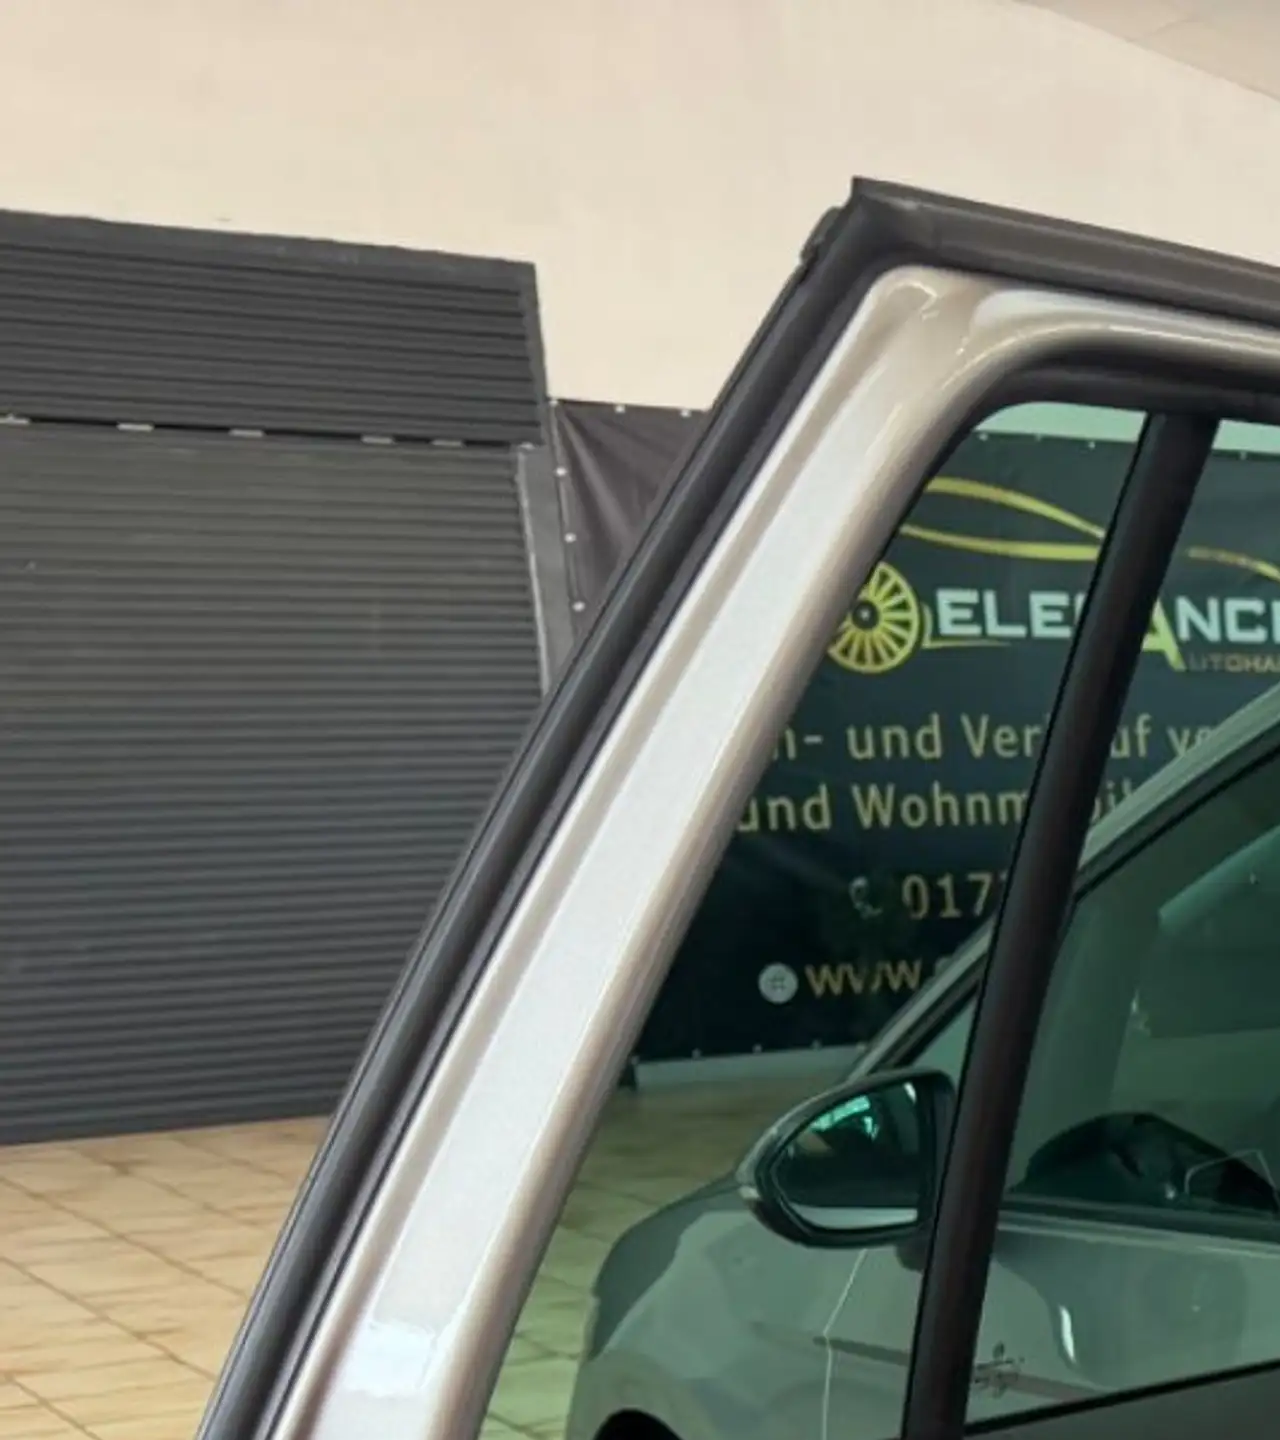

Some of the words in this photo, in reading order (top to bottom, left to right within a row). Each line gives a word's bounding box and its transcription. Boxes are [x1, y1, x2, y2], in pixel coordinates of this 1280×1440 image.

[846, 713, 943, 760] und
[959, 712, 1152, 760] Veruf
[902, 868, 1009, 920] 017
